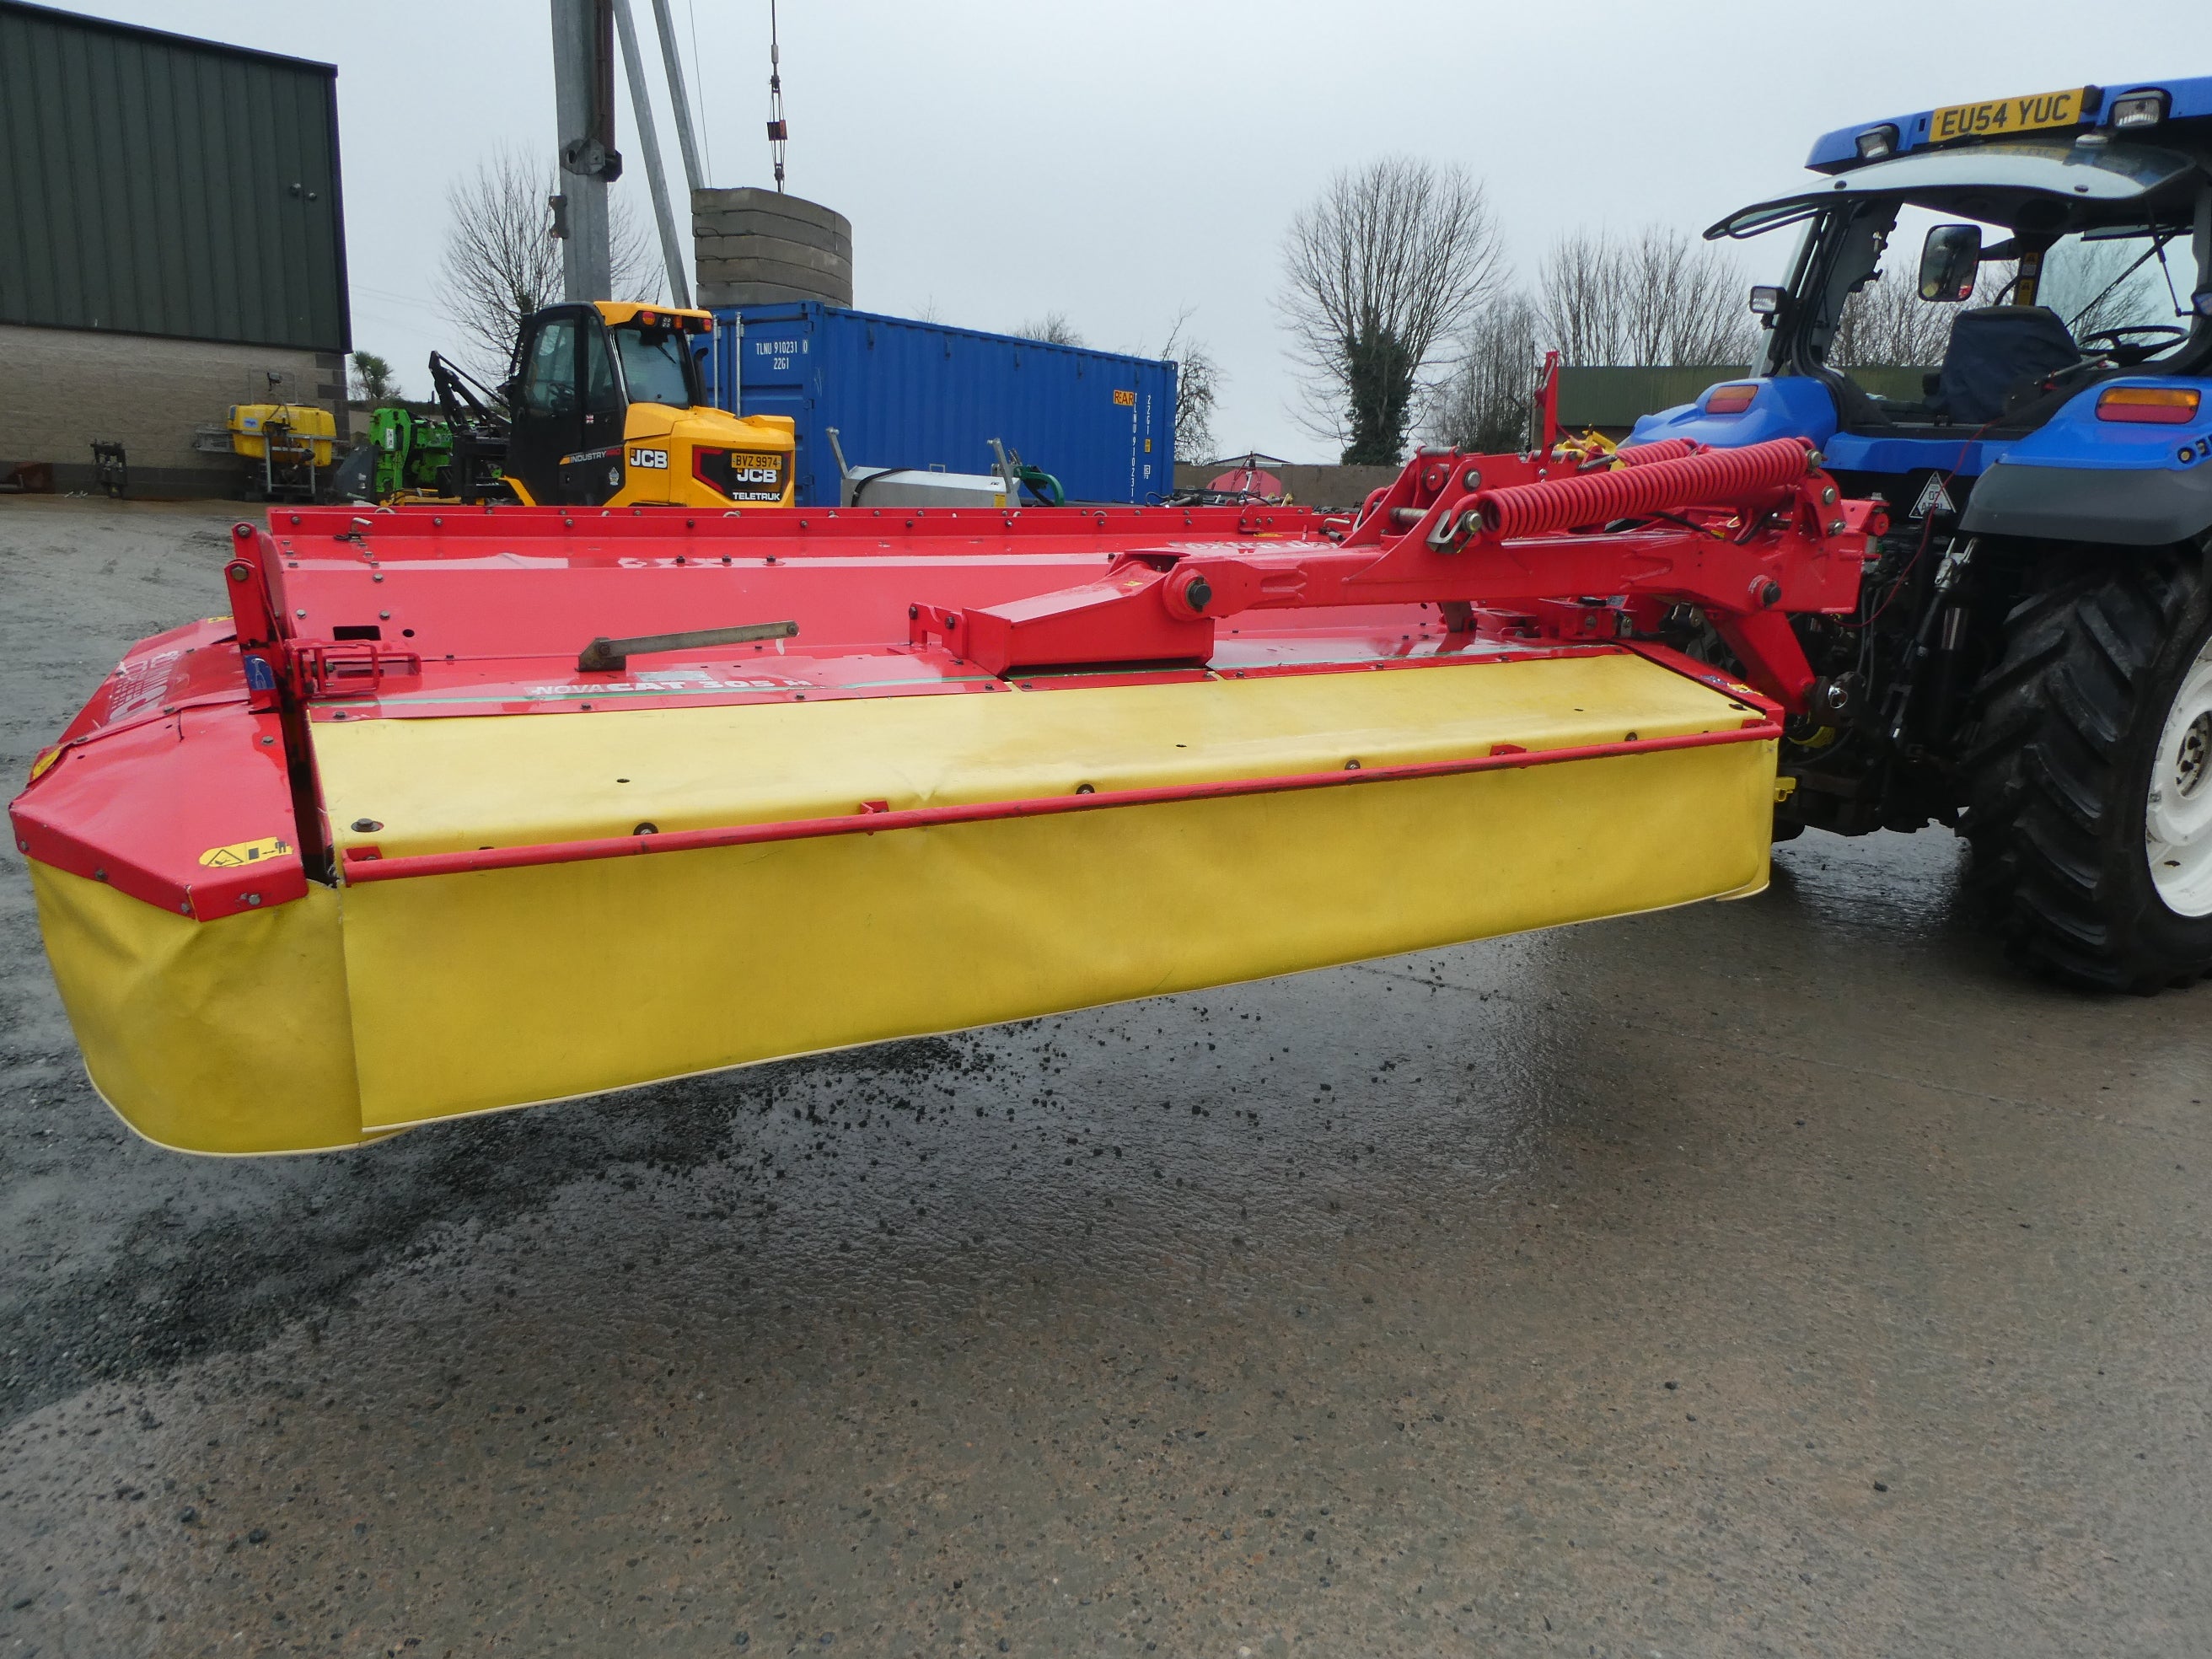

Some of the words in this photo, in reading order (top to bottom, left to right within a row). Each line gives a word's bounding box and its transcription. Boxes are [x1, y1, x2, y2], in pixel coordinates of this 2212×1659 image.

[1940, 102, 2008, 137] EU54
[2019, 94, 2071, 126] YUC
[755, 342, 772, 355] TLNU
[774, 341, 797, 354] 910231
[773, 357, 789, 370] 22G1
[1114, 390, 1134, 405] REAR
[570, 450, 607, 464] INDUSTRY
[630, 449, 668, 469] JCB
[736, 455, 754, 467] BVZ
[756, 456, 778, 468] 9974
[737, 468, 777, 483] JCB
[733, 491, 781, 501] TELETRUK
[531, 681, 686, 695] NOVACAT
[699, 680, 776, 689] 305
